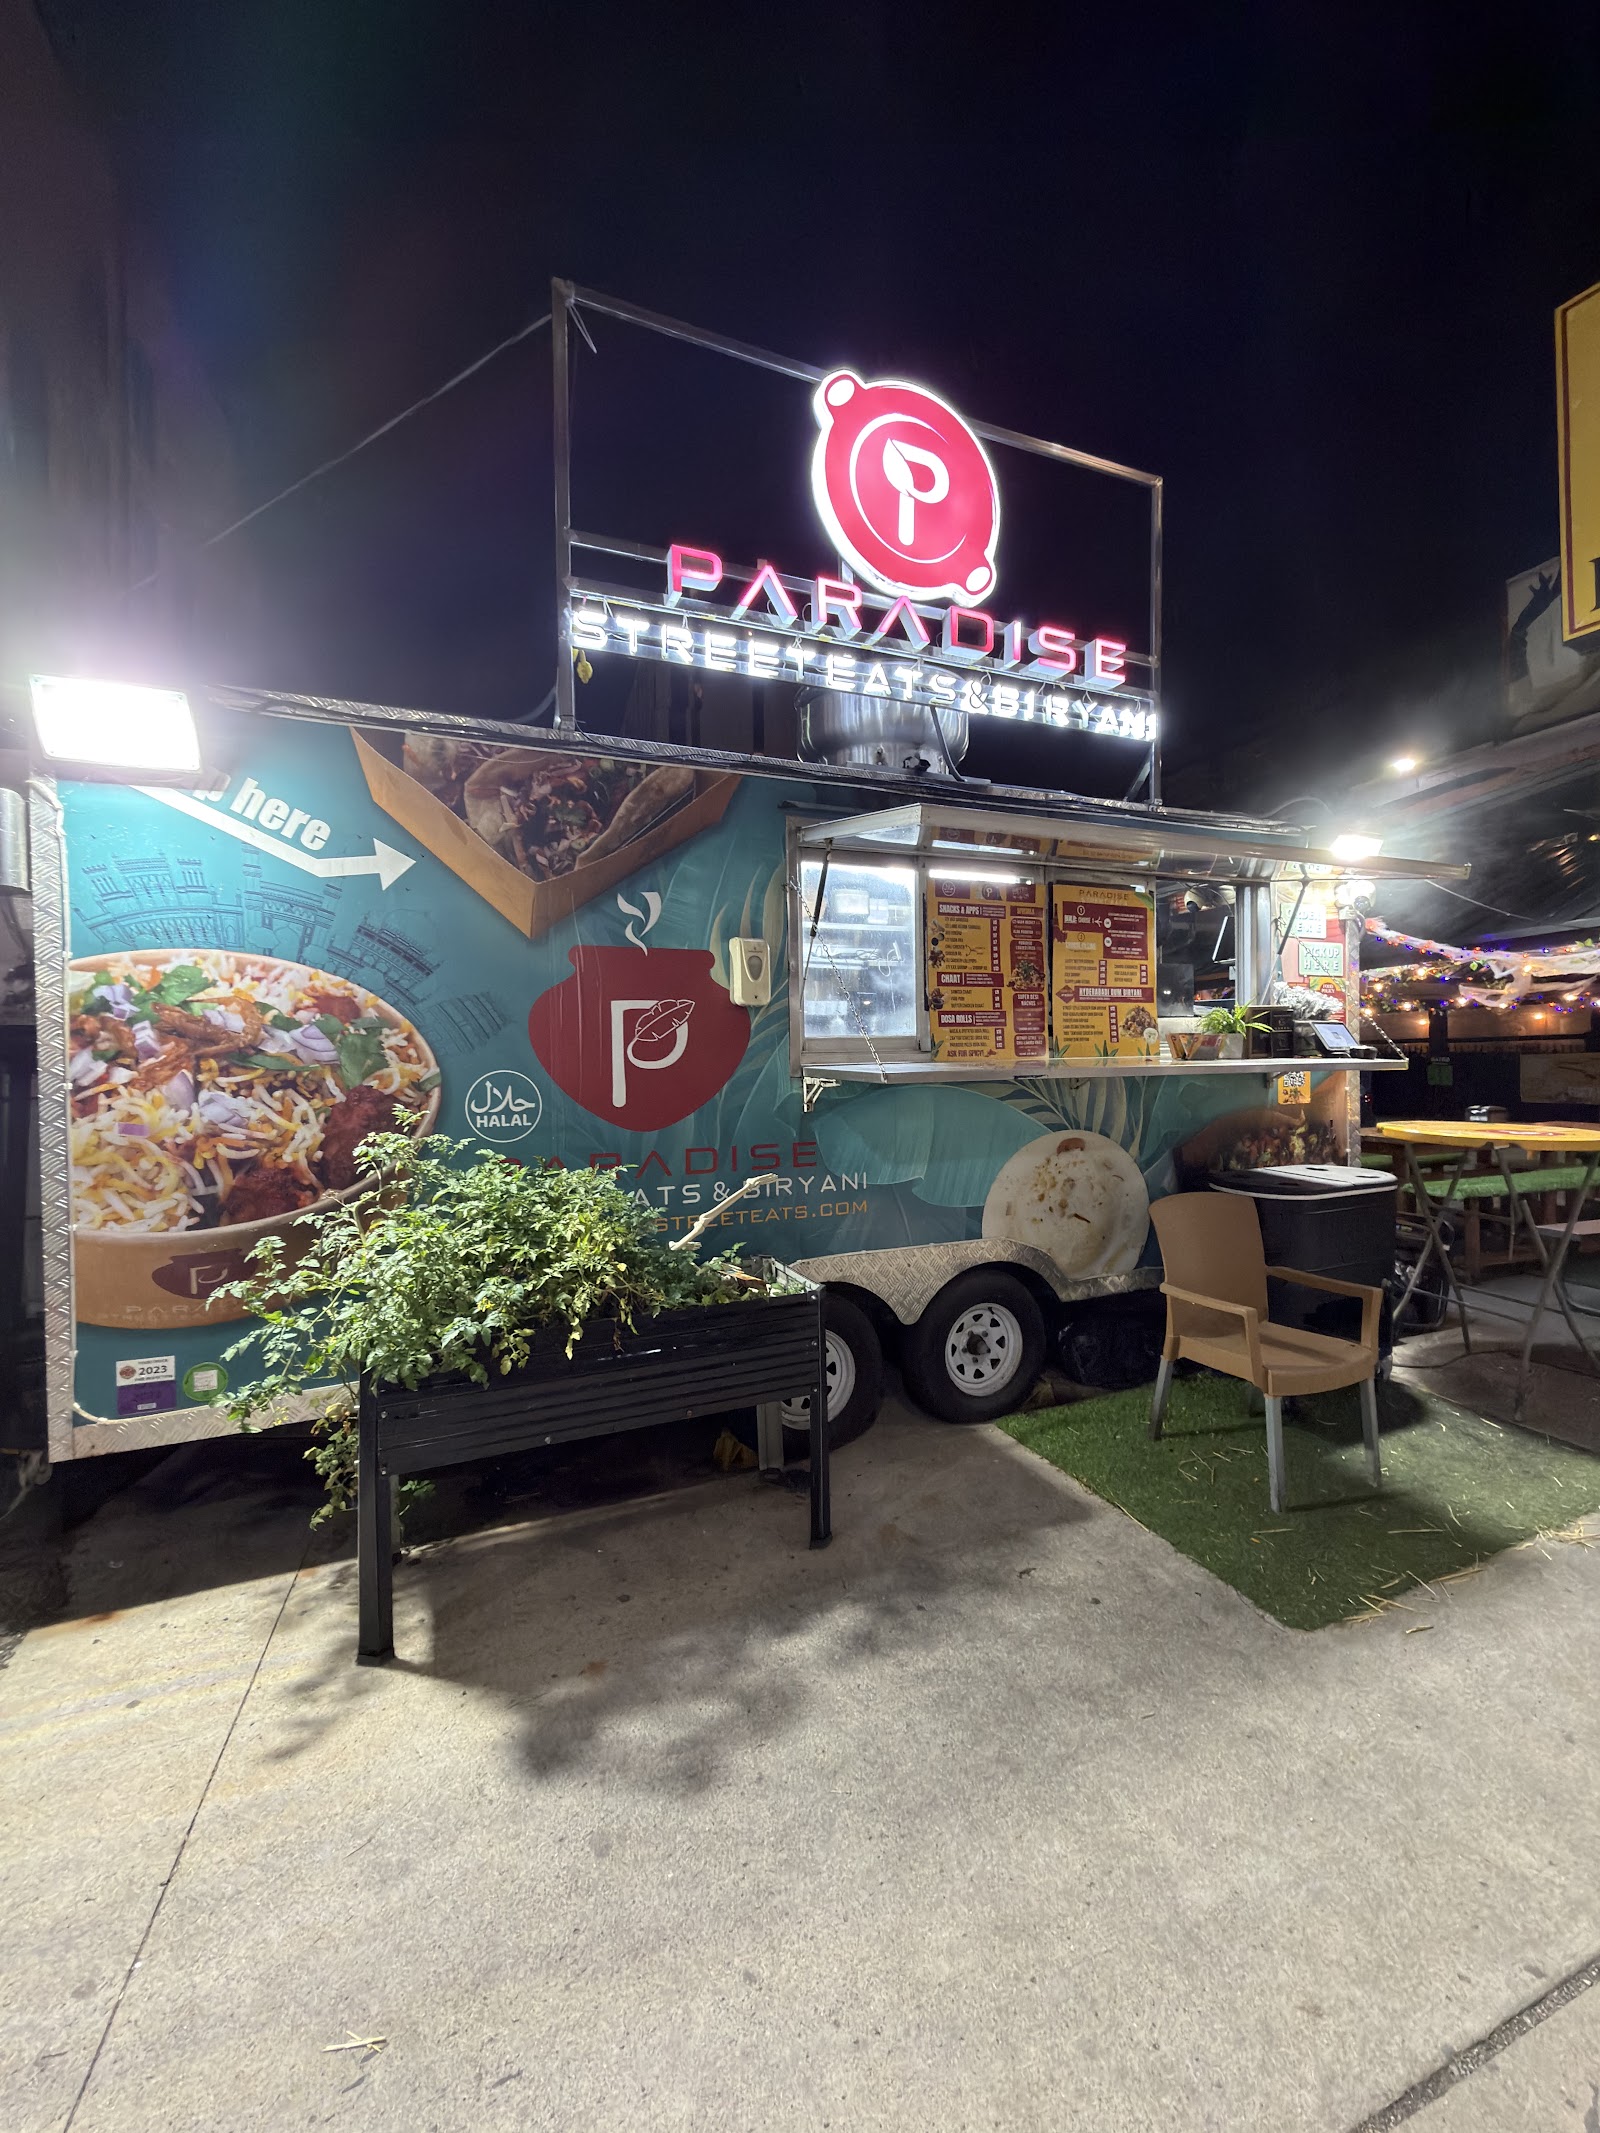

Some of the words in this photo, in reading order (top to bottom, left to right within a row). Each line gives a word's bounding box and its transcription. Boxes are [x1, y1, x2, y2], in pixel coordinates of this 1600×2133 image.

[668, 544, 1126, 689] PARADISE
[229, 777, 331, 851] here
[1079, 889, 1129, 900] PARADISE
[939, 904, 960, 914] SNACKS
[965, 906, 980, 915] APPS
[1303, 960, 1339, 972] HERE
[941, 974, 961, 984] CHAAT
[1079, 987, 1110, 996] HYDERABADI
[940, 1014, 956, 1024] DOSA
[956, 1014, 973, 1024] ROLLS
[470, 1080, 536, 1113] حلال
[476, 1113, 532, 1128] HALAL
[713, 1181, 732, 1202] &
[655, 1199, 867, 1232] STRETEATS.COM
[138, 1365, 168, 1376] 2023
